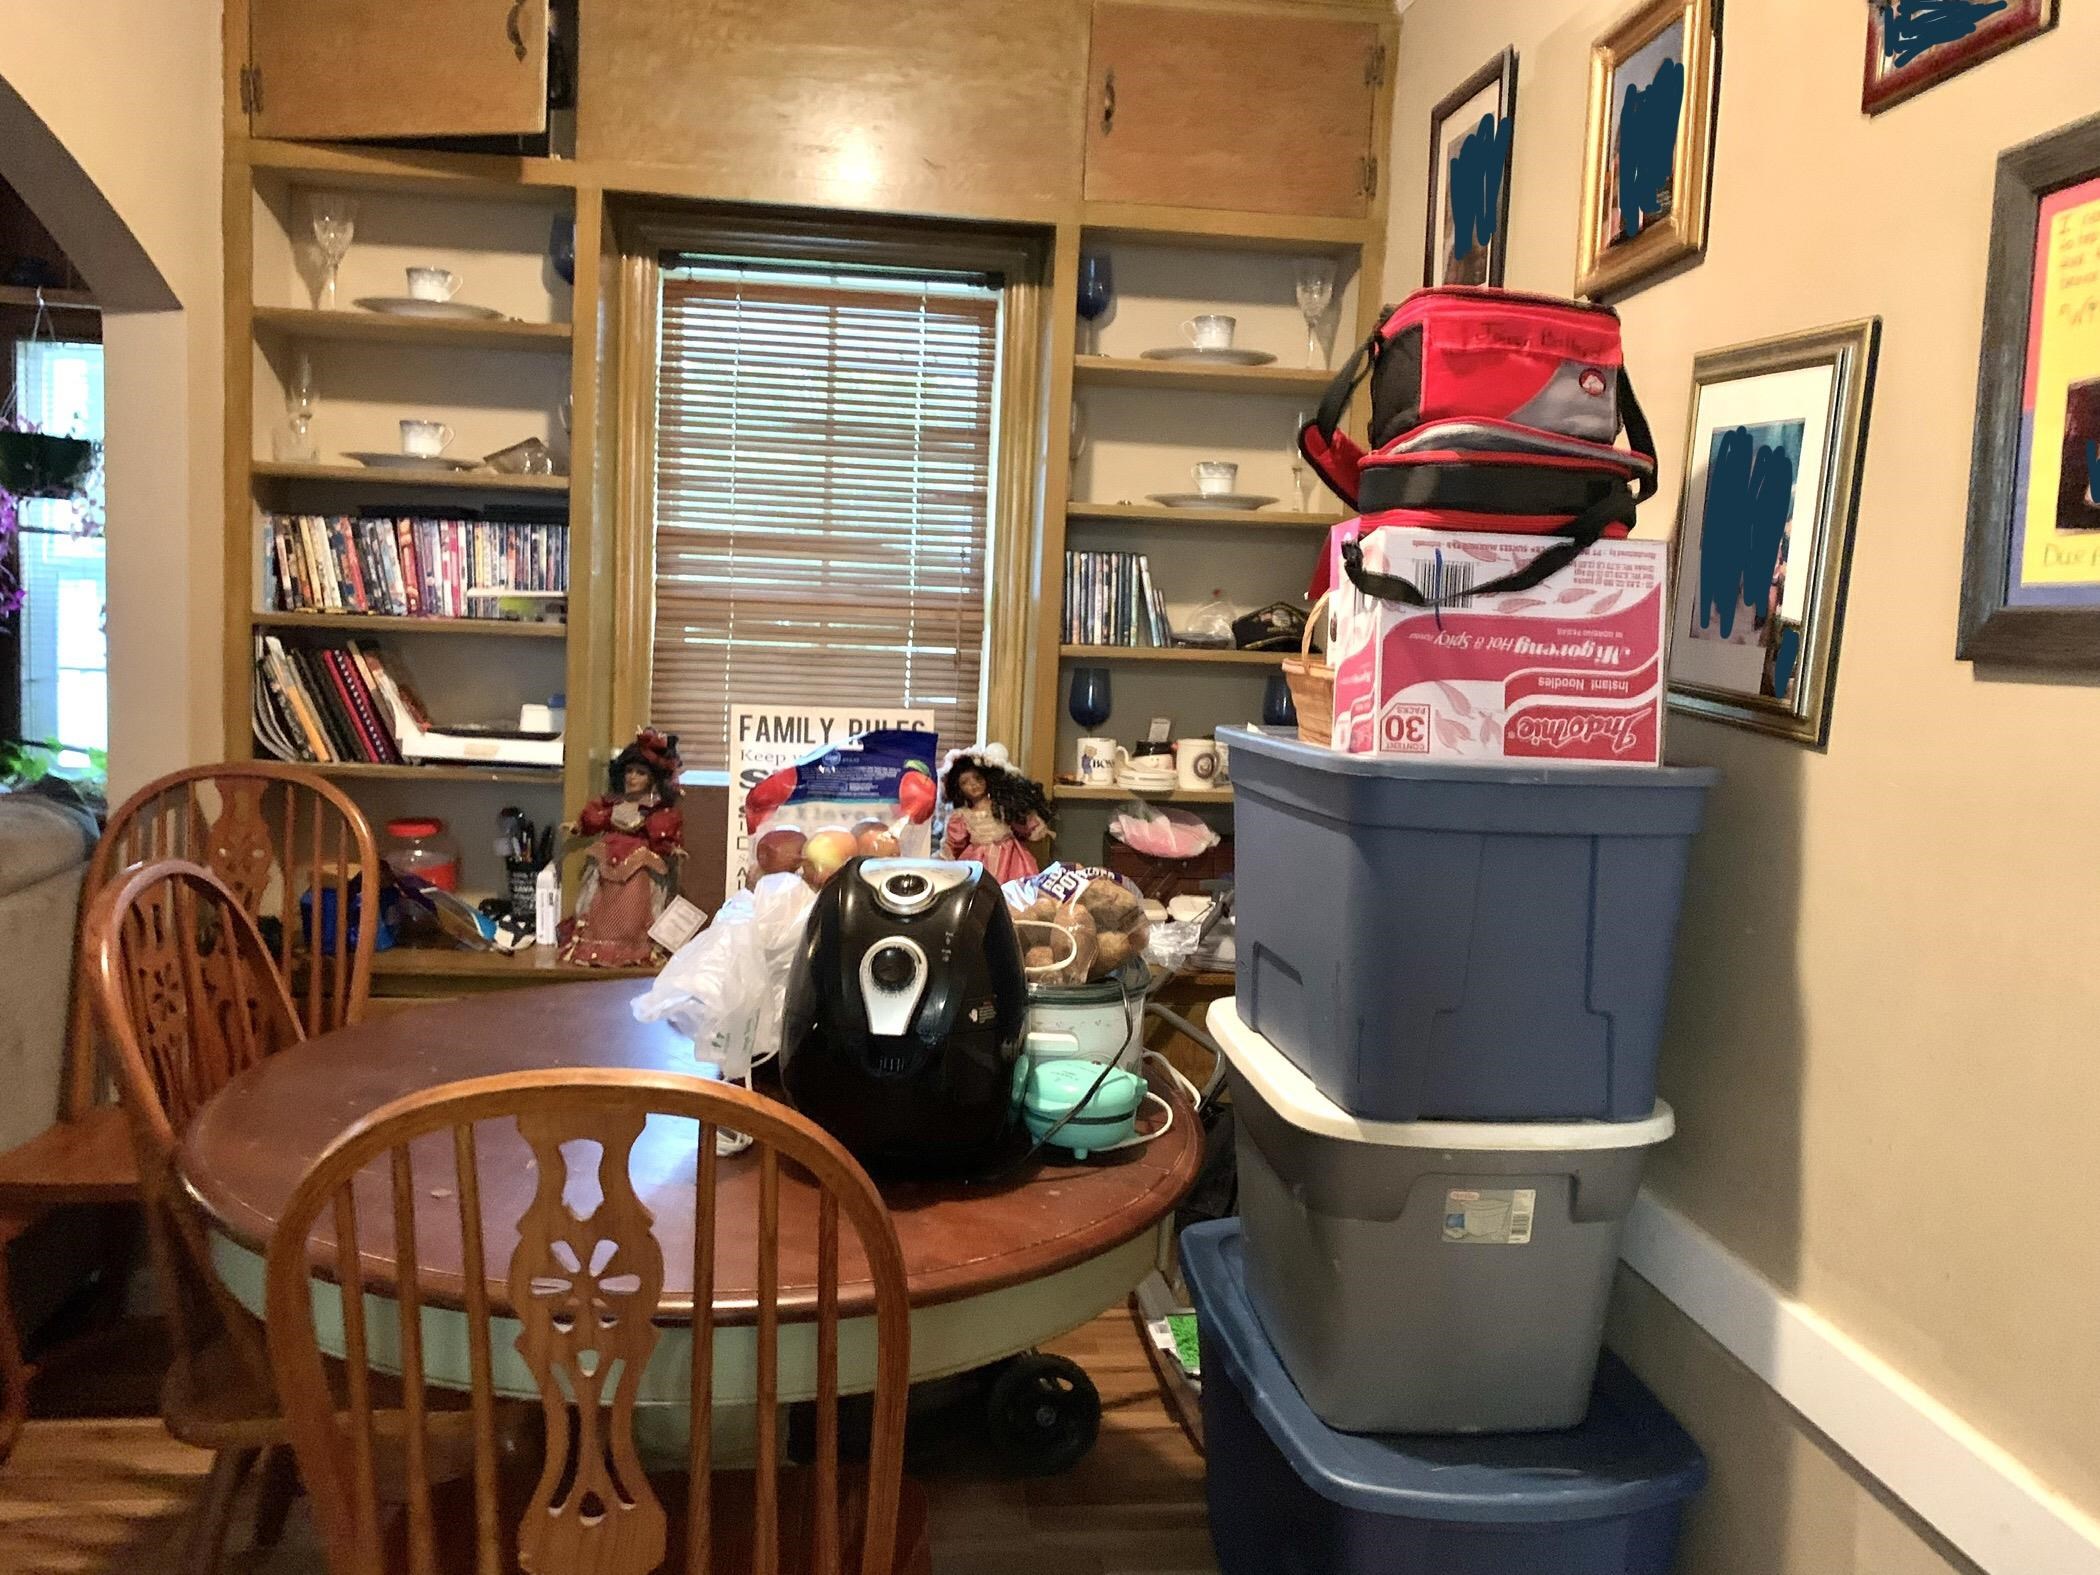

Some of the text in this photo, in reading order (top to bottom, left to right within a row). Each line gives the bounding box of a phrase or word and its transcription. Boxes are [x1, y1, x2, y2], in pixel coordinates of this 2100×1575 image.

[1432, 629, 1473, 650] Spicy
[1485, 636, 1515, 652] Hot
[1537, 676, 1629, 694] Instant Noodles
[739, 714, 835, 745] FAMILY
[1385, 715, 1425, 743] 30
[1516, 705, 1653, 754] Indomie
[740, 750, 786, 765] Keep
